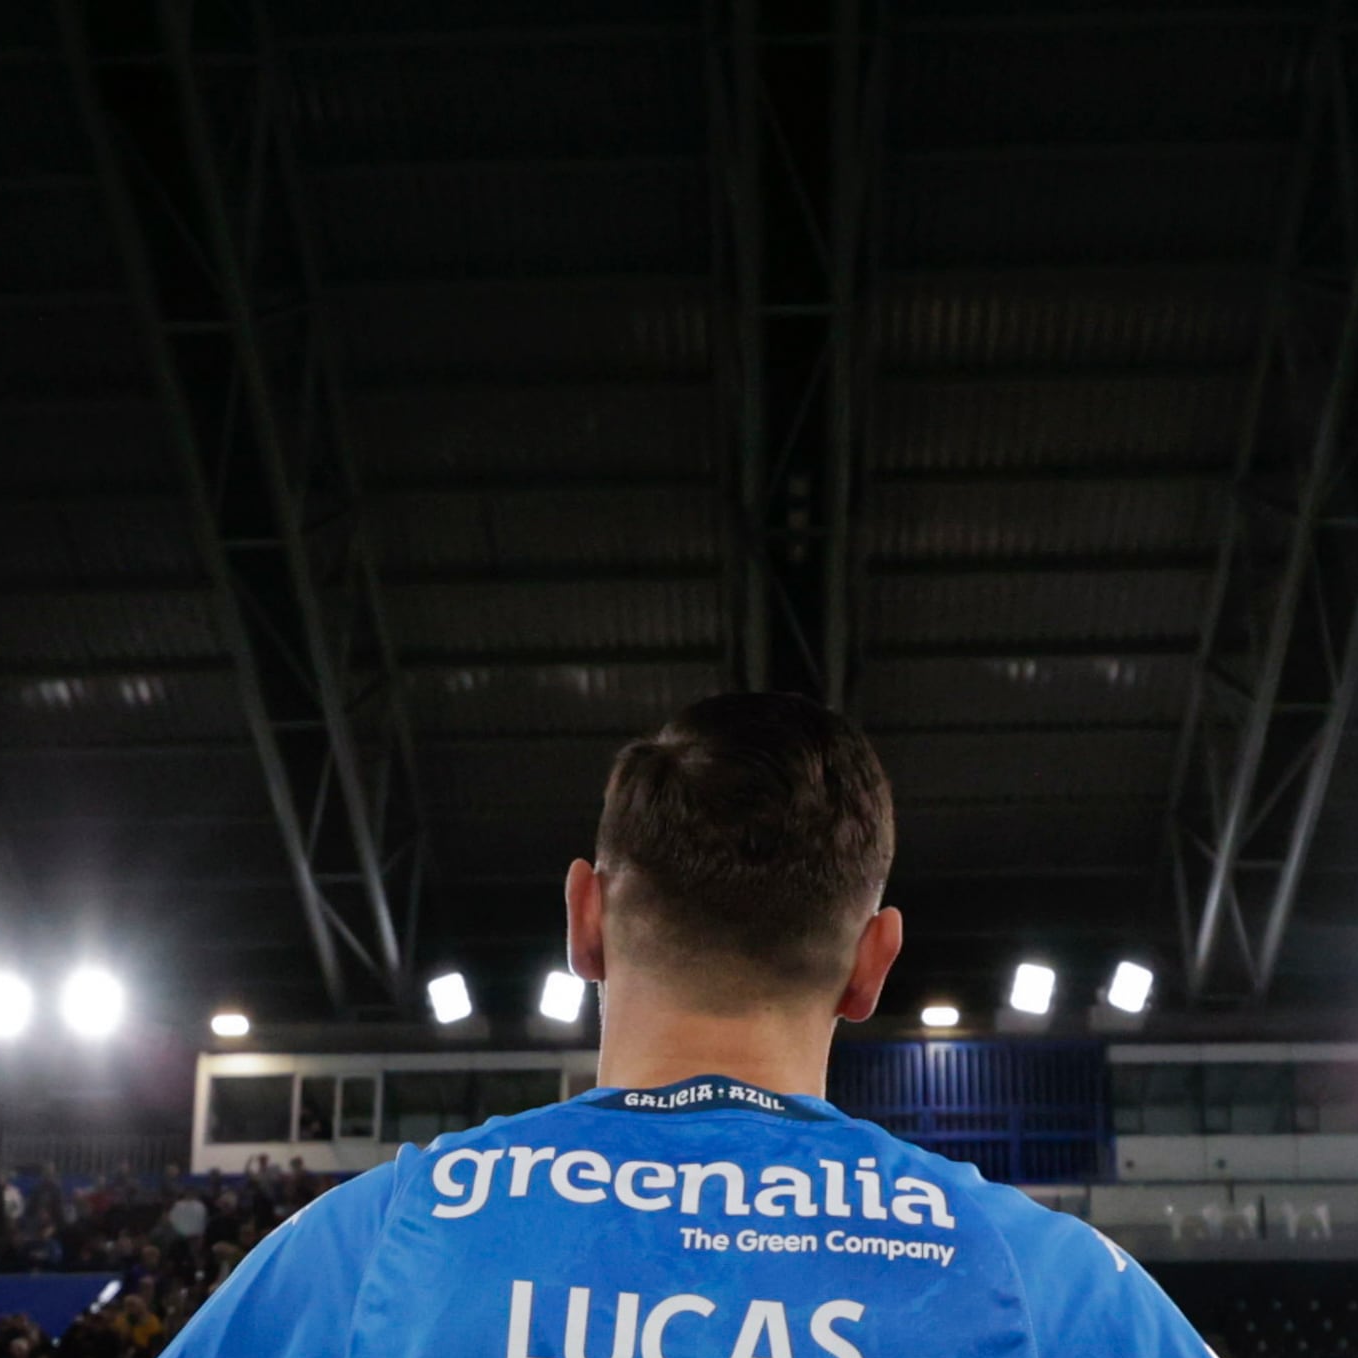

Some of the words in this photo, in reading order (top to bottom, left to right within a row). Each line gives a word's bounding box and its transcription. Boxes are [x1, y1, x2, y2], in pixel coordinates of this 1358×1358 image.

[729, 1086, 784, 1110] AZUL
[431, 1146, 957, 1229] greenalia
[680, 1228, 729, 1251] The
[736, 1230, 817, 1254] Green
[826, 1230, 956, 1268] Company
